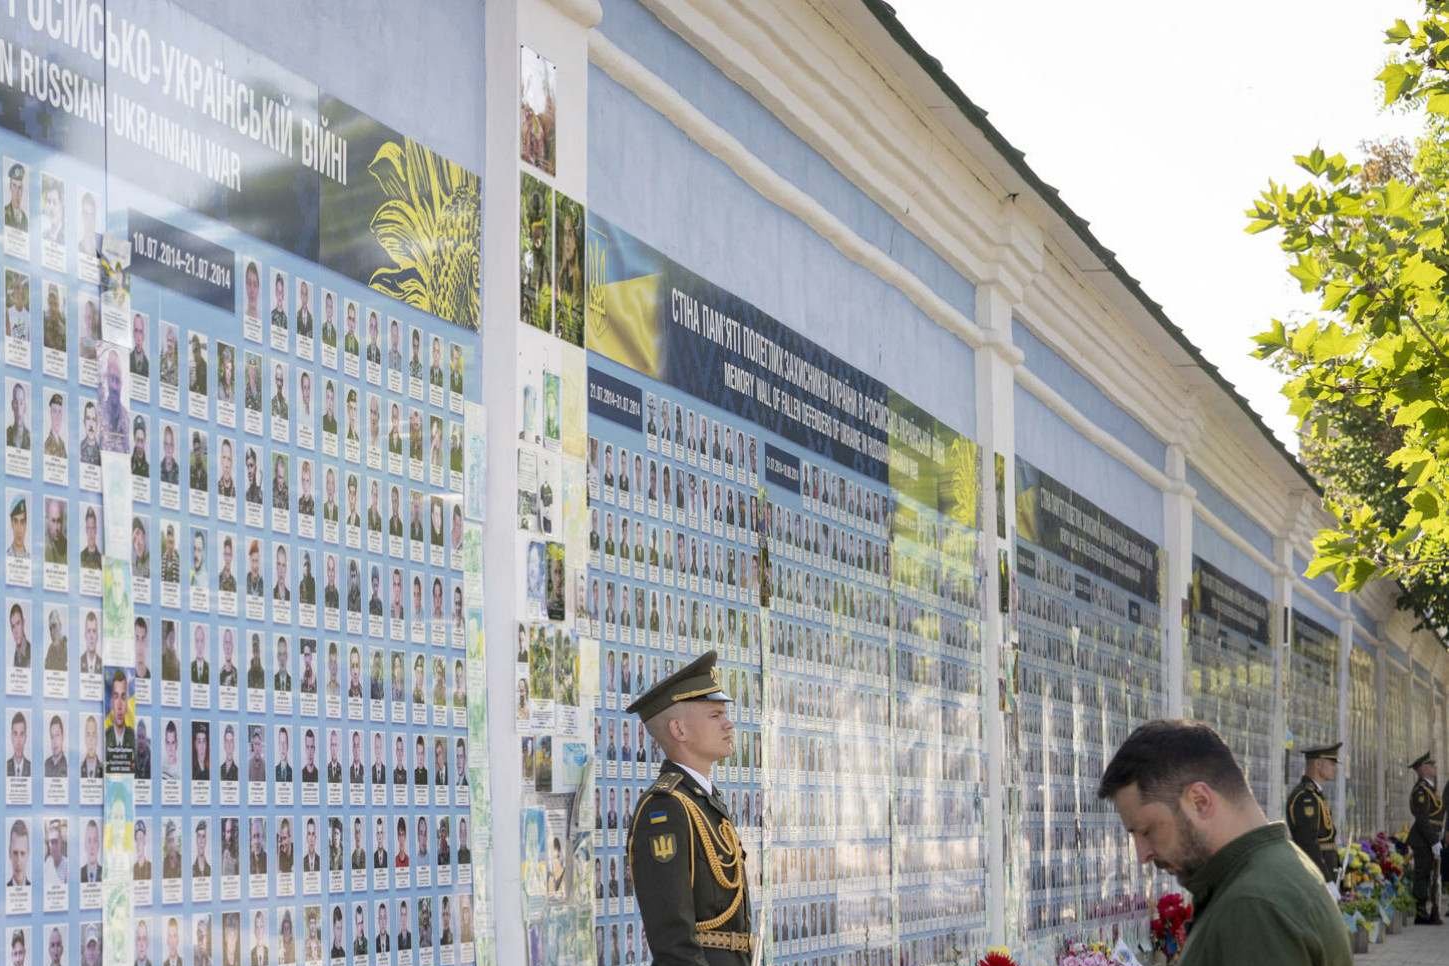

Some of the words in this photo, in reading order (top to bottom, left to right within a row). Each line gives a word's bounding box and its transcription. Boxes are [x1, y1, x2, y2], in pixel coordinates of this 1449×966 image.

[206, 138, 242, 193] WAR
[301, 114, 348, 187] ВІЙНІ
[671, 287, 701, 335] СТІНА
[742, 325, 785, 379] ПОЛЕГЛИХ
[723, 361, 755, 399] MEMORY
[755, 376, 772, 408] WALL
[772, 386, 781, 412] OF
